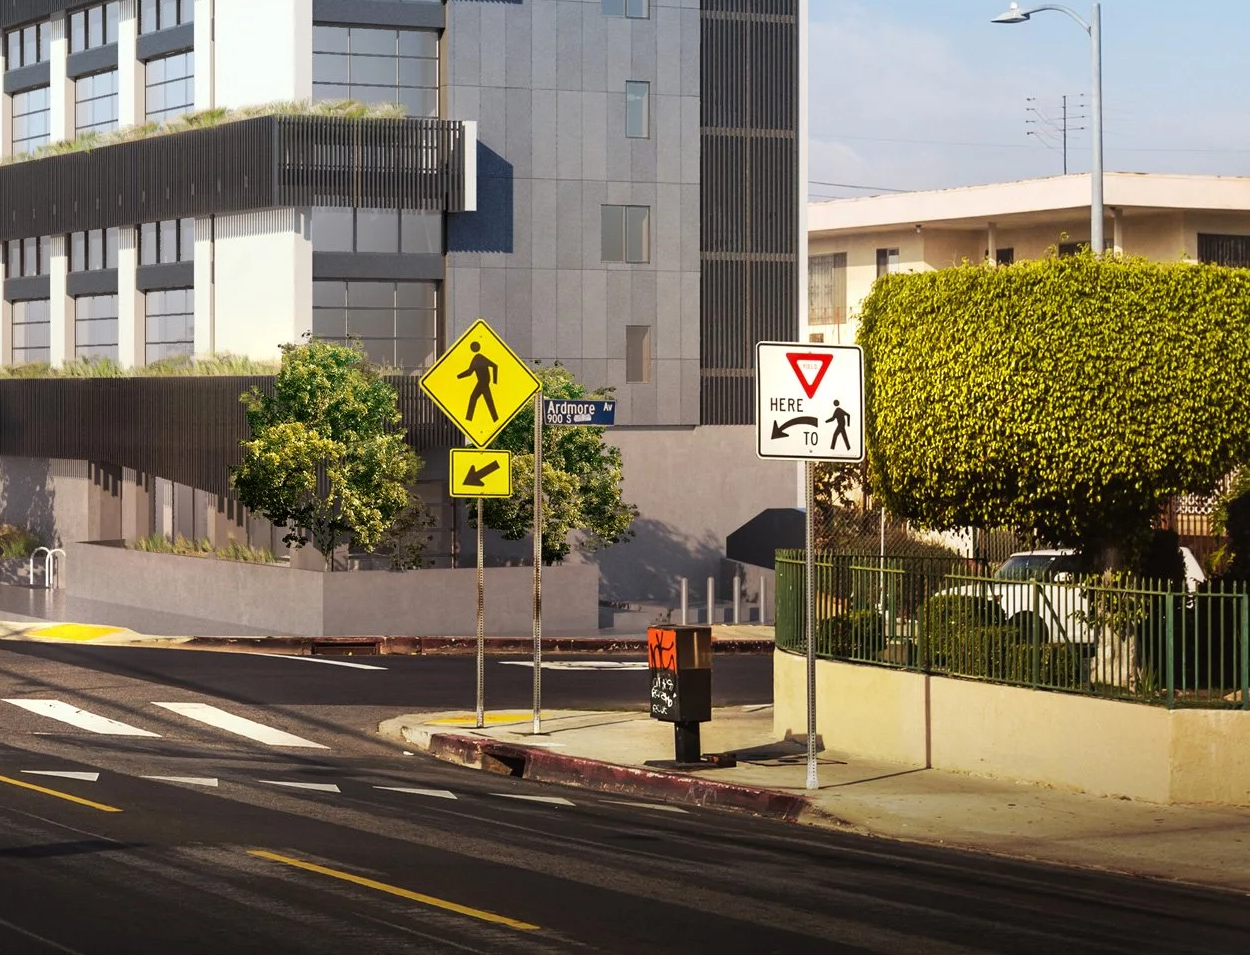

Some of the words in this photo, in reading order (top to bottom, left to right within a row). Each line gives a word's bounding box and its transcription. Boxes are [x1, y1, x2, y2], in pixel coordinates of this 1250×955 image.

[547, 400, 596, 415] Ardmore
[603, 402, 613, 412] Av
[770, 397, 804, 412] HERE
[547, 413, 563, 424] 900
[566, 413, 572, 424] S
[803, 431, 819, 446] TO
